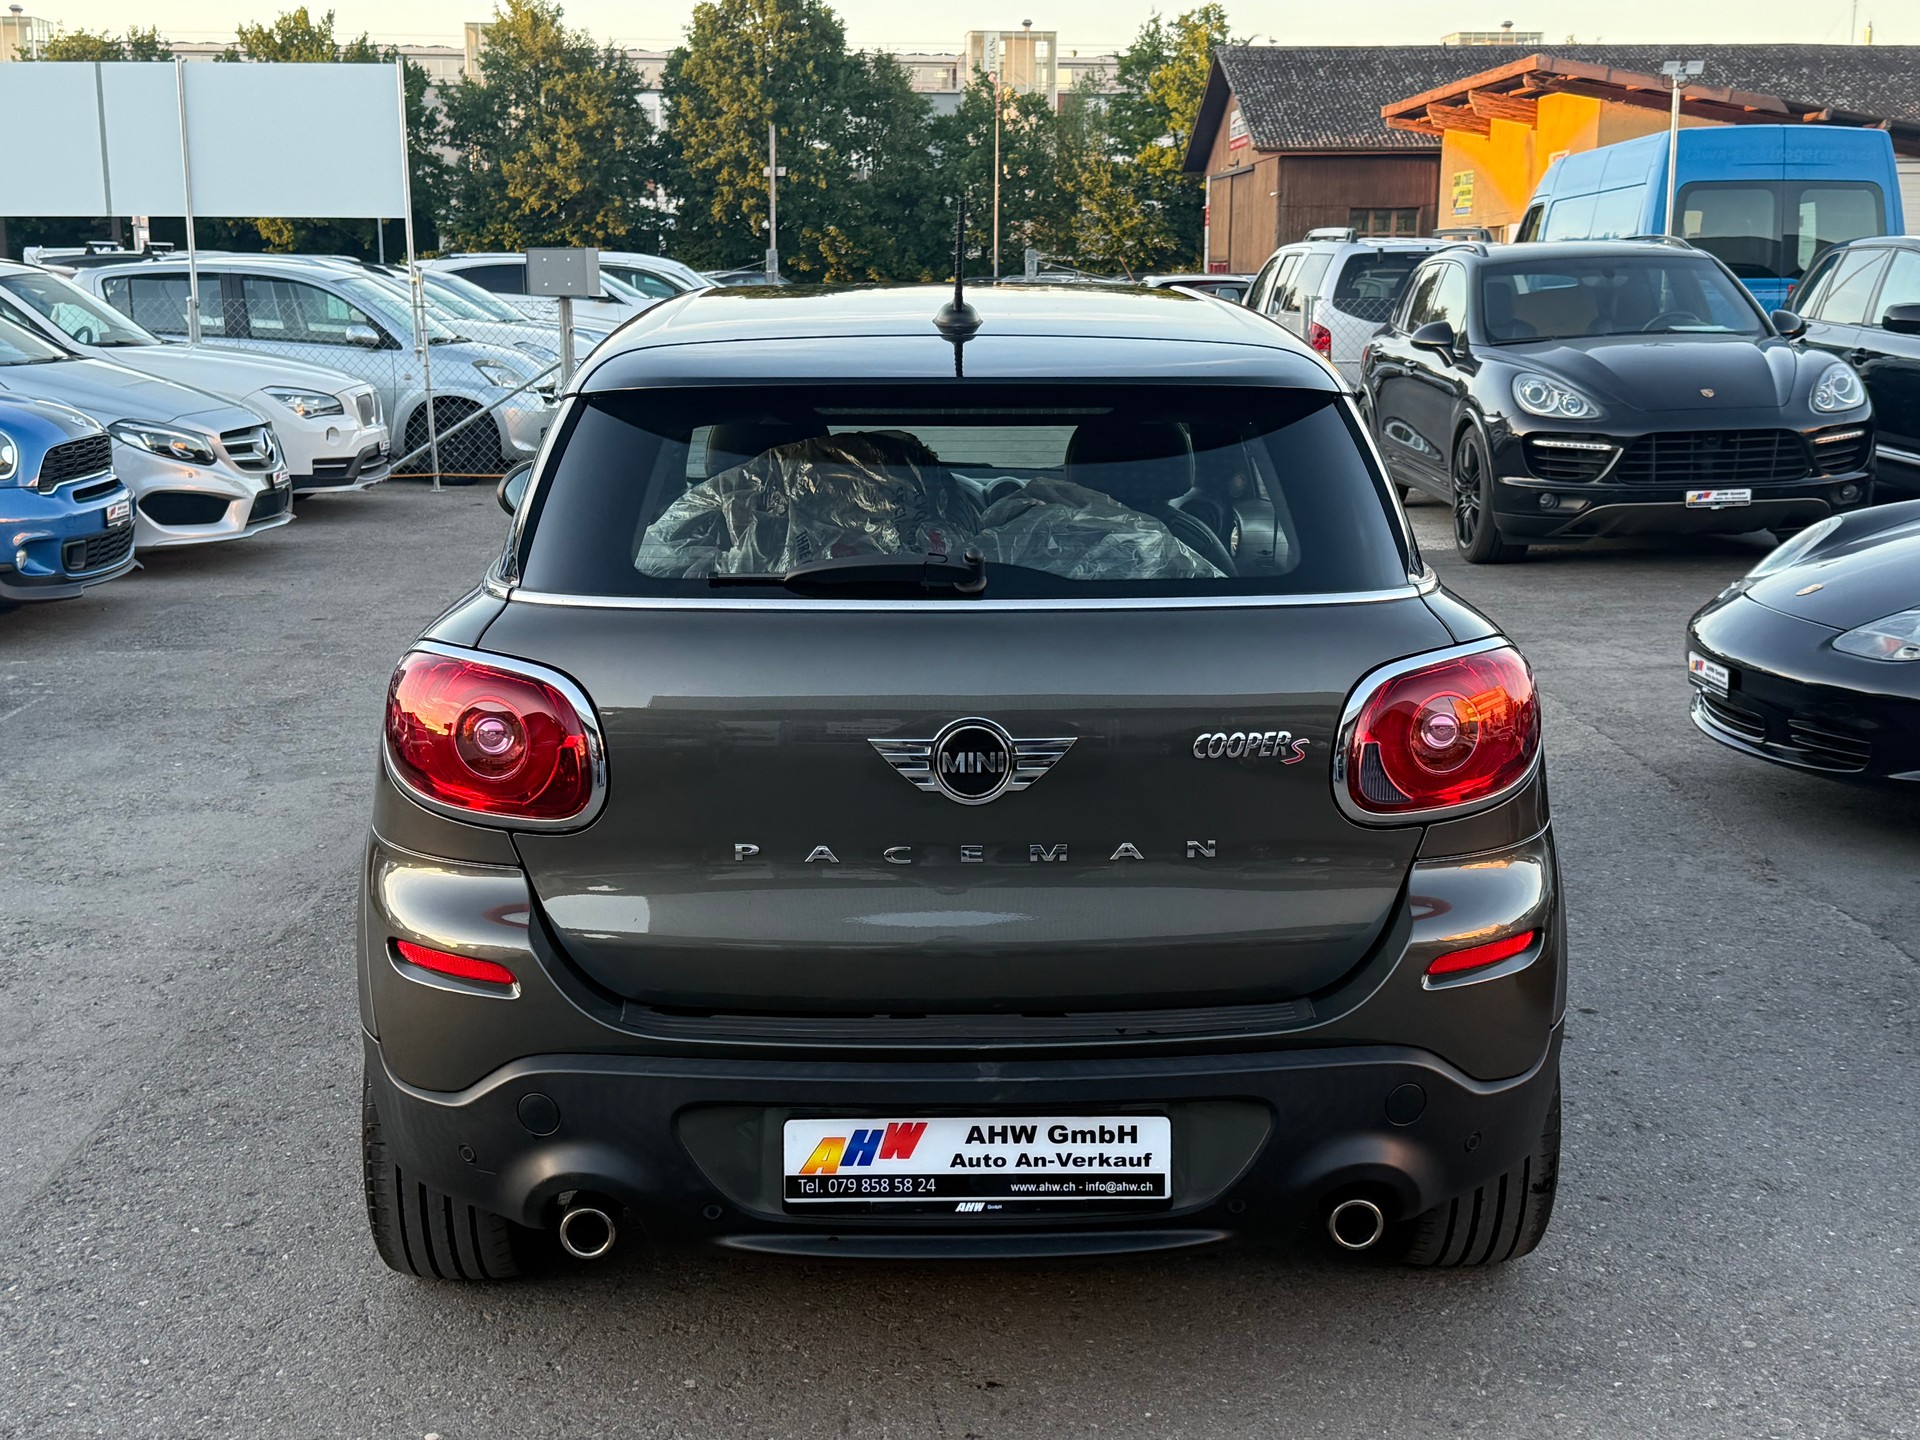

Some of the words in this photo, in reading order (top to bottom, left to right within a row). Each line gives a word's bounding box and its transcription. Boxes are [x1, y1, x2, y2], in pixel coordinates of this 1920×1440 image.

[1193, 731, 1292, 759] COOPER
[1280, 738, 1311, 765] S
[942, 751, 1005, 774] MINI
[734, 839, 1217, 865] PACEMAN
[965, 1125, 1038, 1145] AHW
[1047, 1124, 1138, 1145] GmbH
[799, 1122, 928, 1175] AHW
[949, 1153, 1007, 1168] Auto
[1015, 1152, 1153, 1168] An-Verkauf
[798, 1178, 824, 1193] Tel.
[828, 1178, 857, 1193] 079
[861, 1178, 890, 1193] 858
[894, 1178, 914, 1193] 58
[917, 1178, 937, 1193] 24
[1010, 1182, 1076, 1192] www.ahw.ch
[1085, 1181, 1154, 1193] info@ahw.ch
[955, 1202, 986, 1213] AHW
